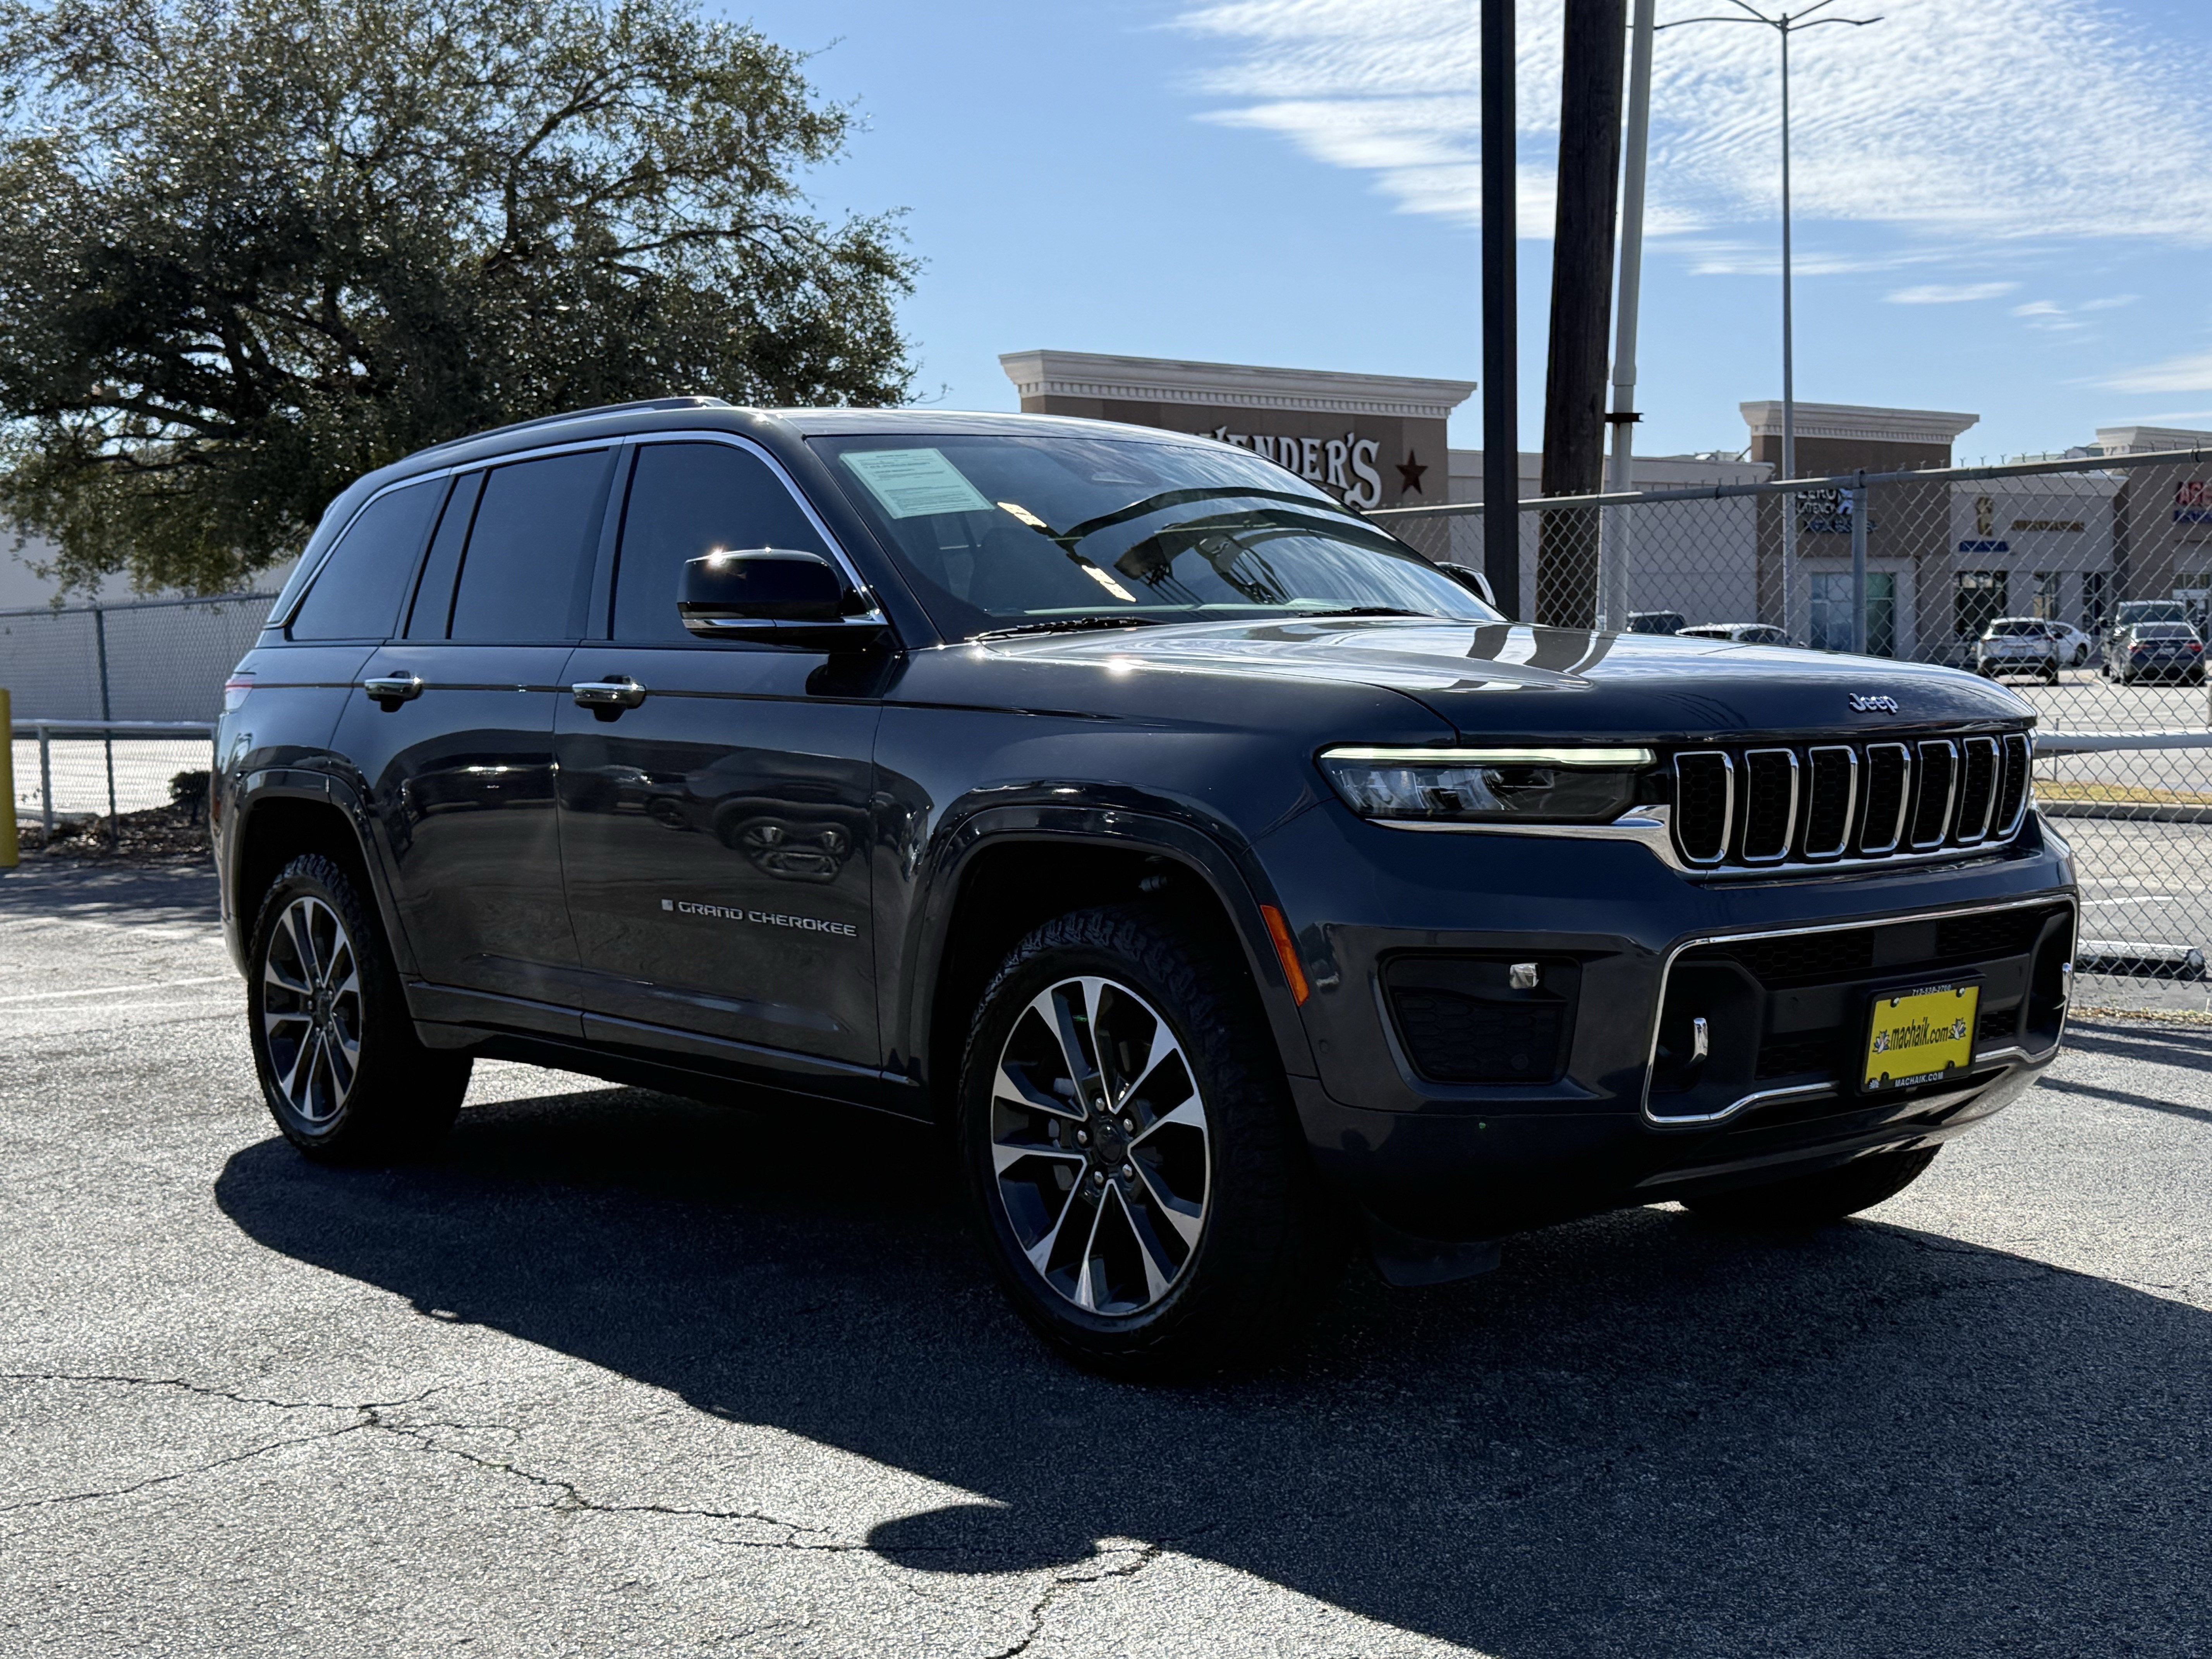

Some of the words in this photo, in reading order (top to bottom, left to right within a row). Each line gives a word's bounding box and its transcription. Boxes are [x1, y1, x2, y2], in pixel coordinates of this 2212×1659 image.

[1850, 693, 1898, 713] Jeep
[678, 902, 743, 920] GRAND
[749, 911, 857, 937] CHEROKEE
[1890, 1016, 1949, 1051] machaik.com
[1895, 1072, 1944, 1087] MACHAIK.COM
